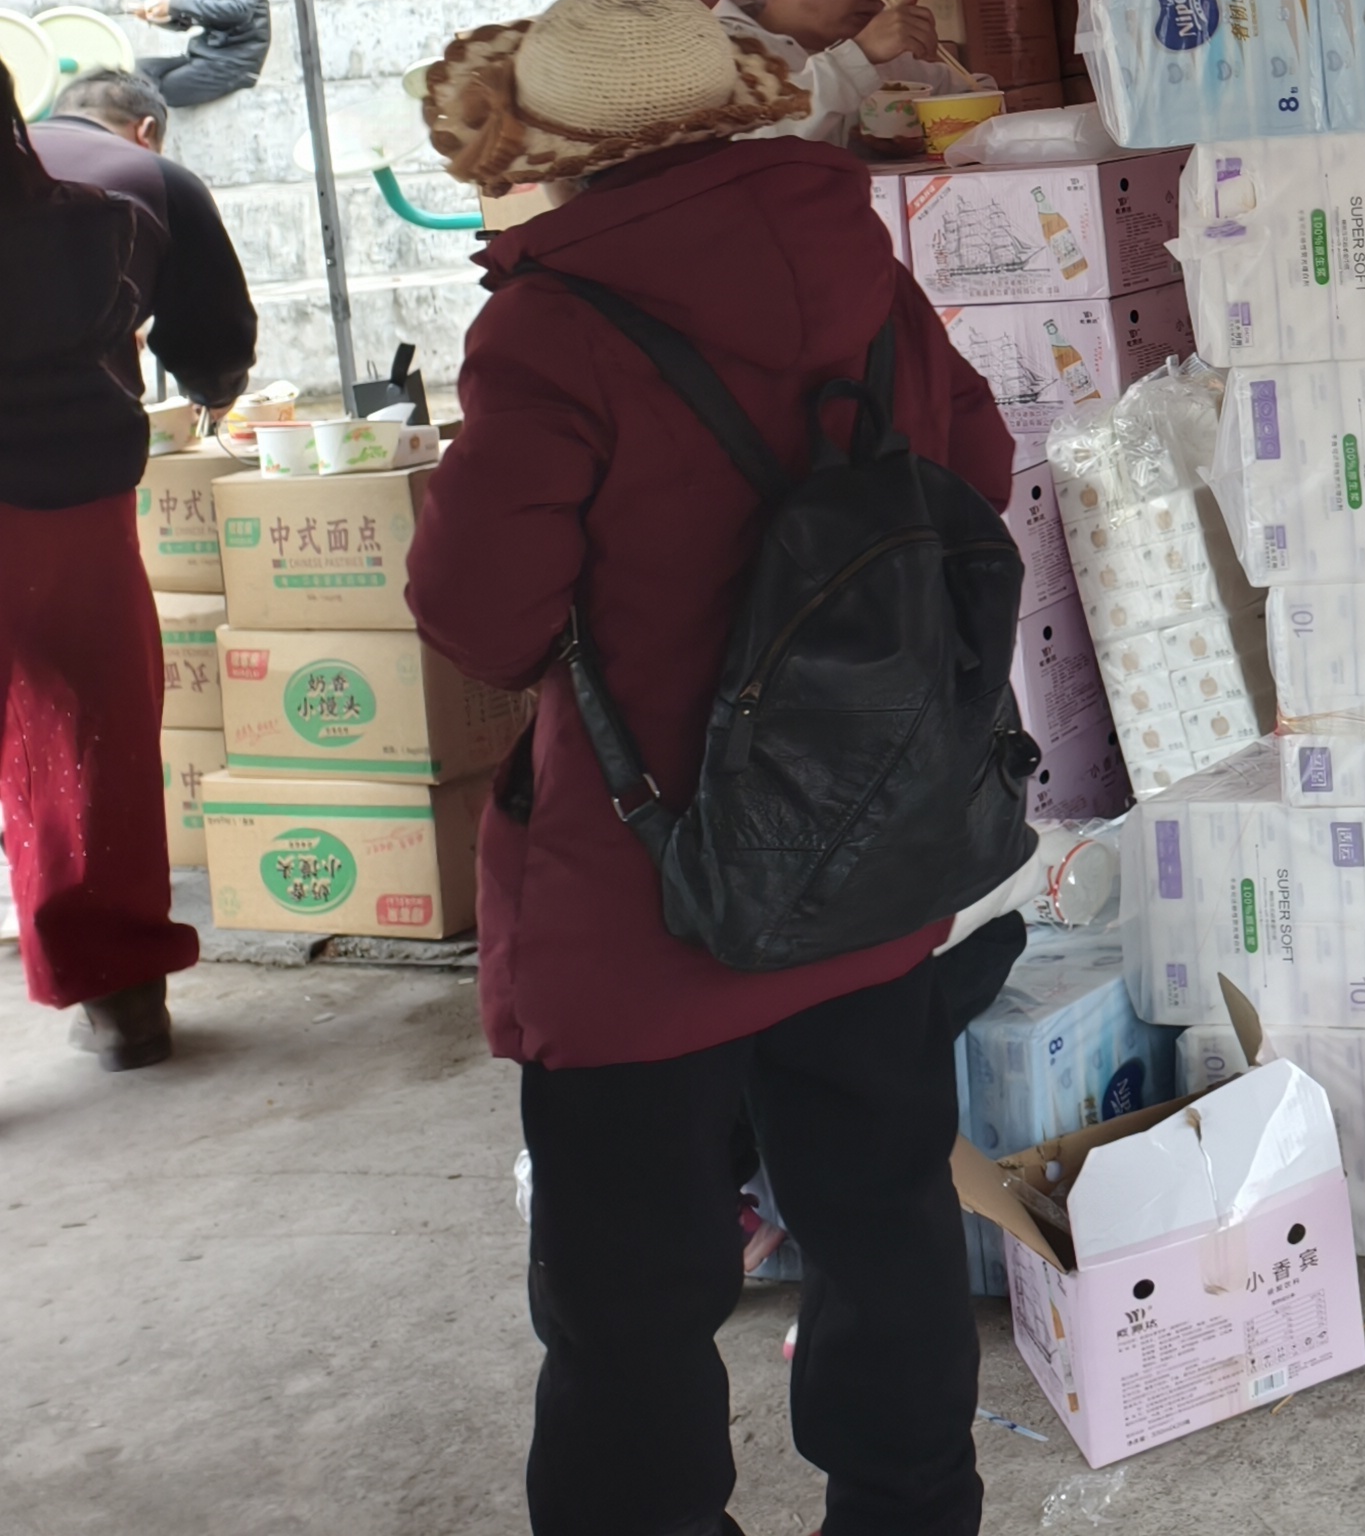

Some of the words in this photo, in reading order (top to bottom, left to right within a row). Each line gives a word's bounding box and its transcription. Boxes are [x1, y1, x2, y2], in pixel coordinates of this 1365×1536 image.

[1278, 96, 1300, 112] 8
[1351, 196, 1365, 251] SUPER
[1314, 216, 1326, 278] 100%原生浆
[1345, 440, 1360, 504] 100%原生浆
[269, 516, 382, 556] 中式面点
[307, 673, 348, 693] 奶香
[297, 695, 361, 718] 小馒头
[1246, 1247, 1319, 1293] 小香宾
